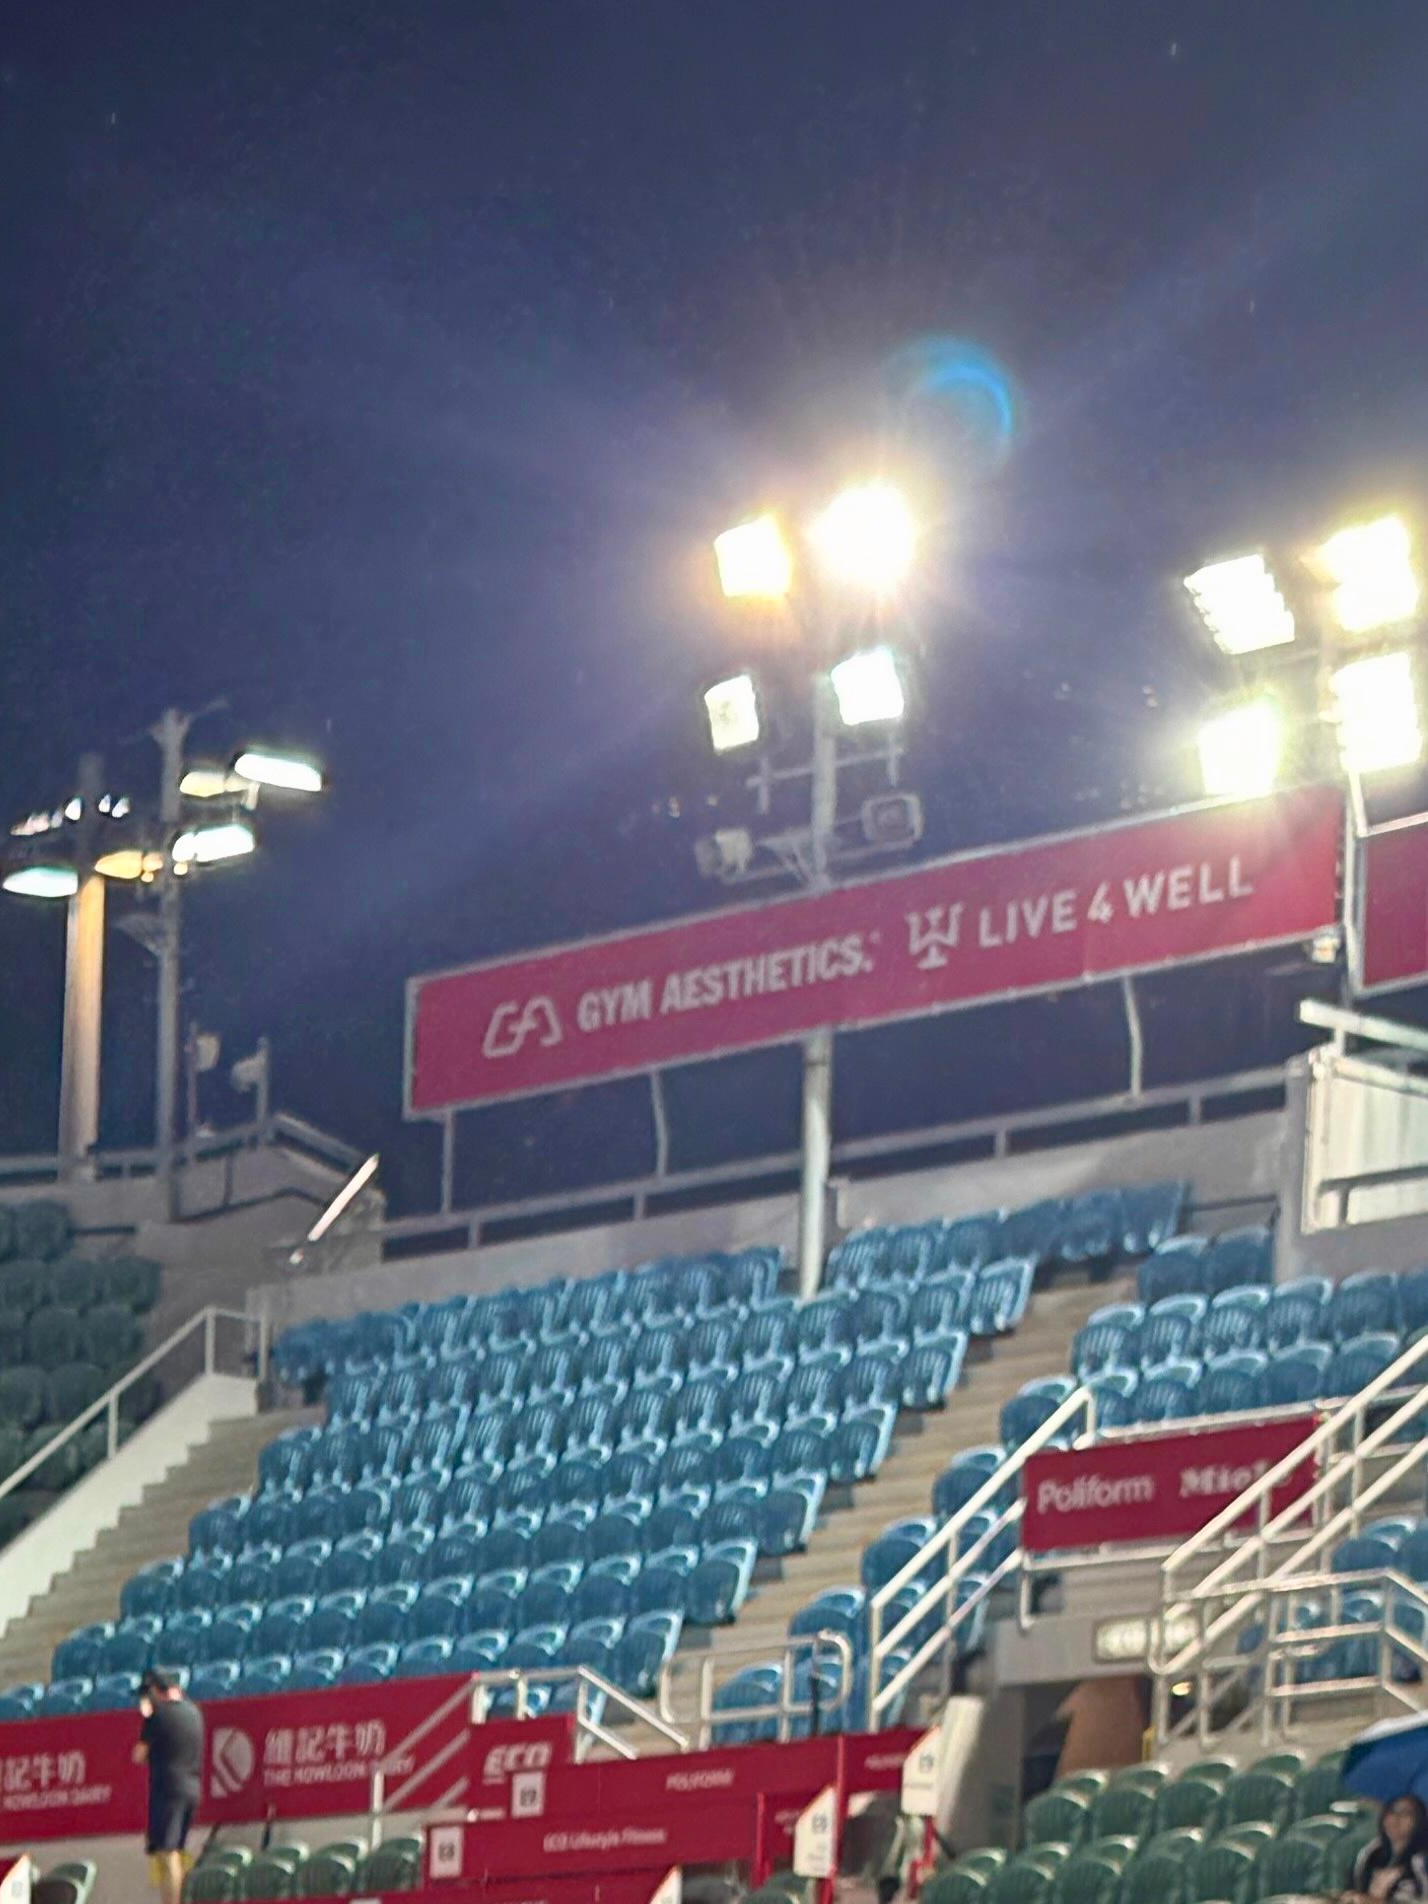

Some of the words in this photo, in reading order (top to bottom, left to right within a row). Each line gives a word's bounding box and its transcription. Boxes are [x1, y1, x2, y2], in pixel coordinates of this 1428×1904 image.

[978, 889, 1077, 949] LIVE
[1087, 881, 1114, 924] 4
[1123, 856, 1255, 920] WELL
[576, 981, 653, 1034] GYM
